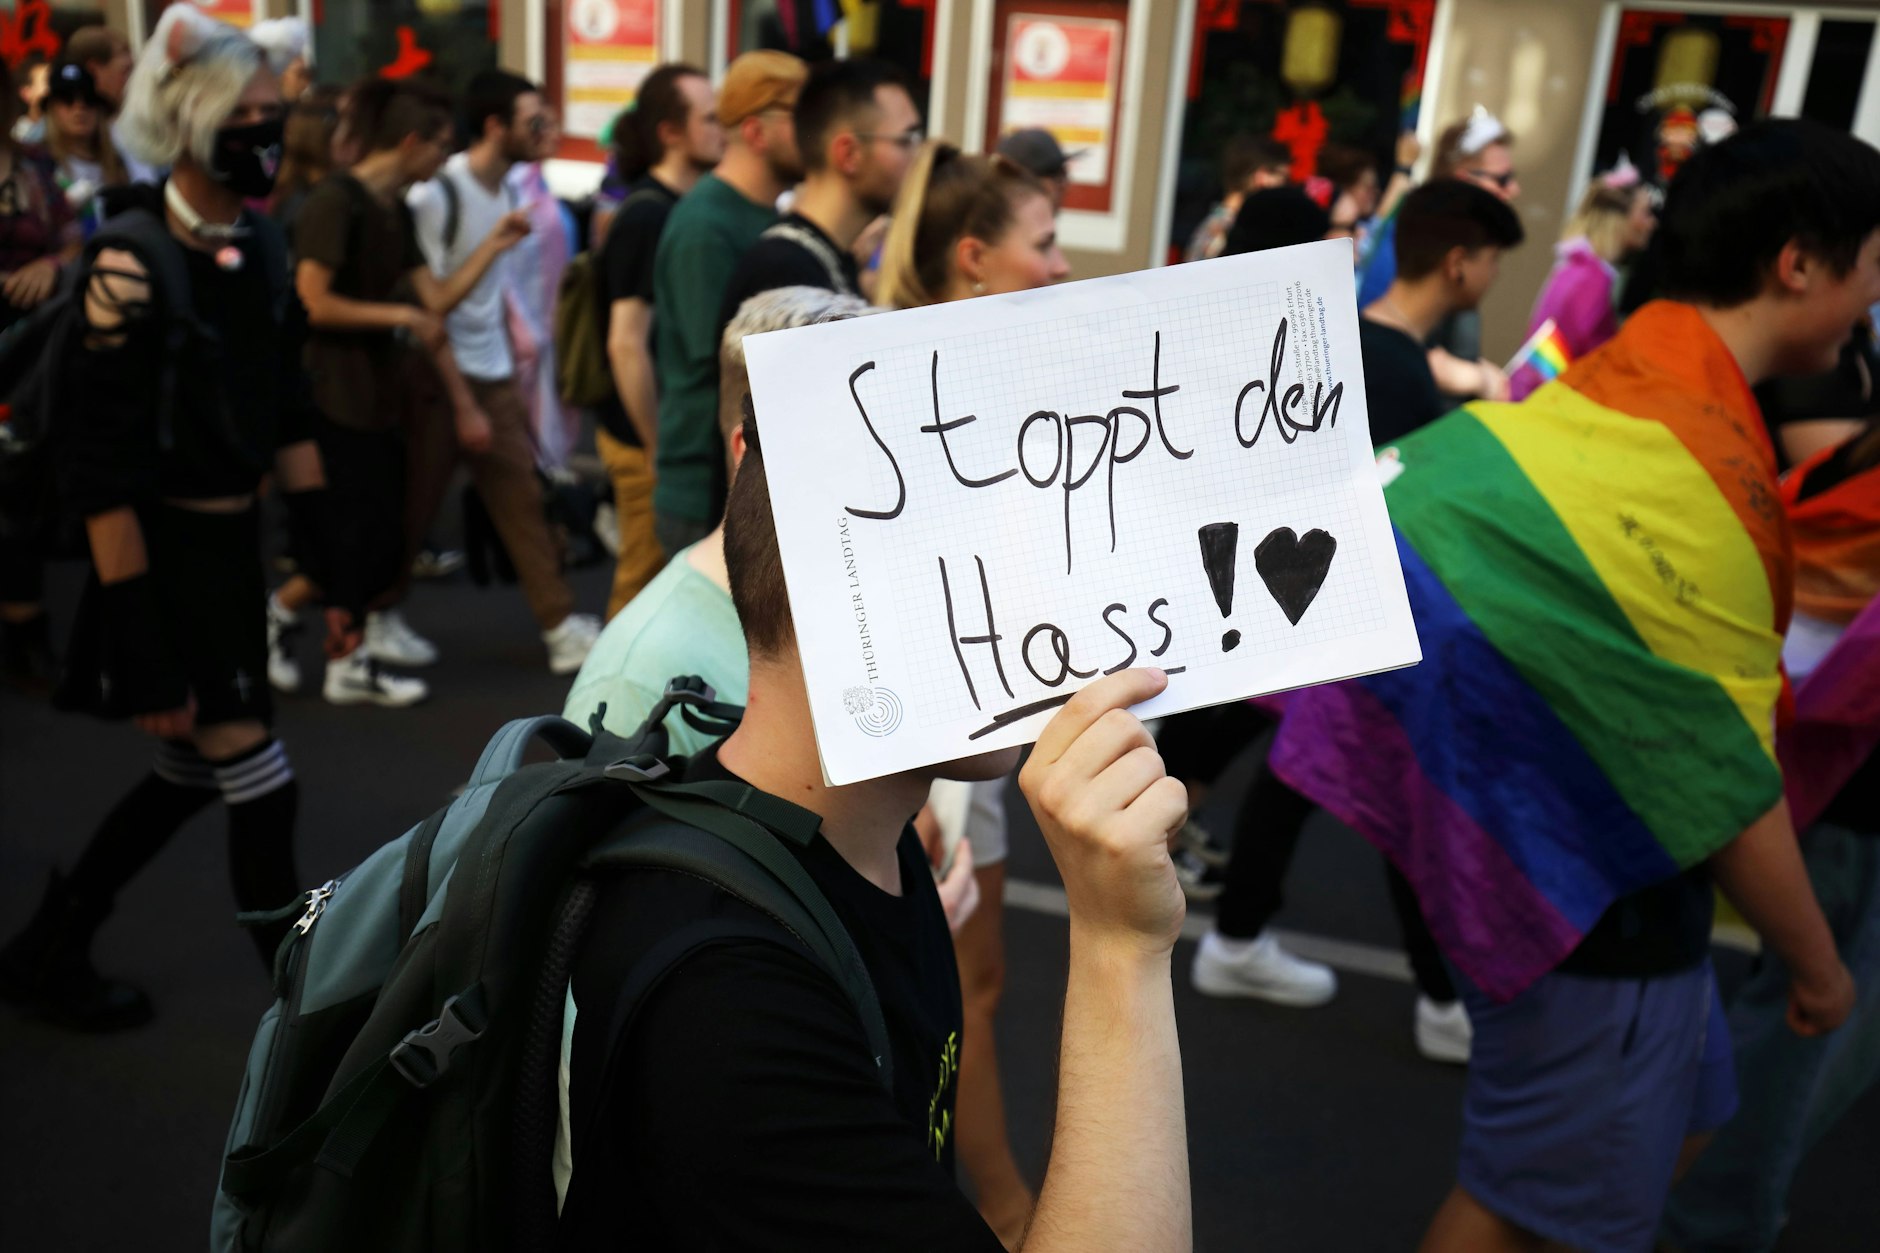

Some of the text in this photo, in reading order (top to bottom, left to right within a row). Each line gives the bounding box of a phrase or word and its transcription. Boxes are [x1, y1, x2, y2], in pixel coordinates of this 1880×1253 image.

[1286, 286, 1294, 308] Erfurt
[1294, 281, 1305, 309] 3772016
[1288, 309, 1299, 334] 99096
[1298, 310, 1306, 327] 0361
[1304, 351, 1313, 371] 37700
[1307, 374, 1315, 389] 0361
[845, 317, 1343, 575] Stoppt den
[837, 517, 879, 683] THÜRINGER LANDTAG
